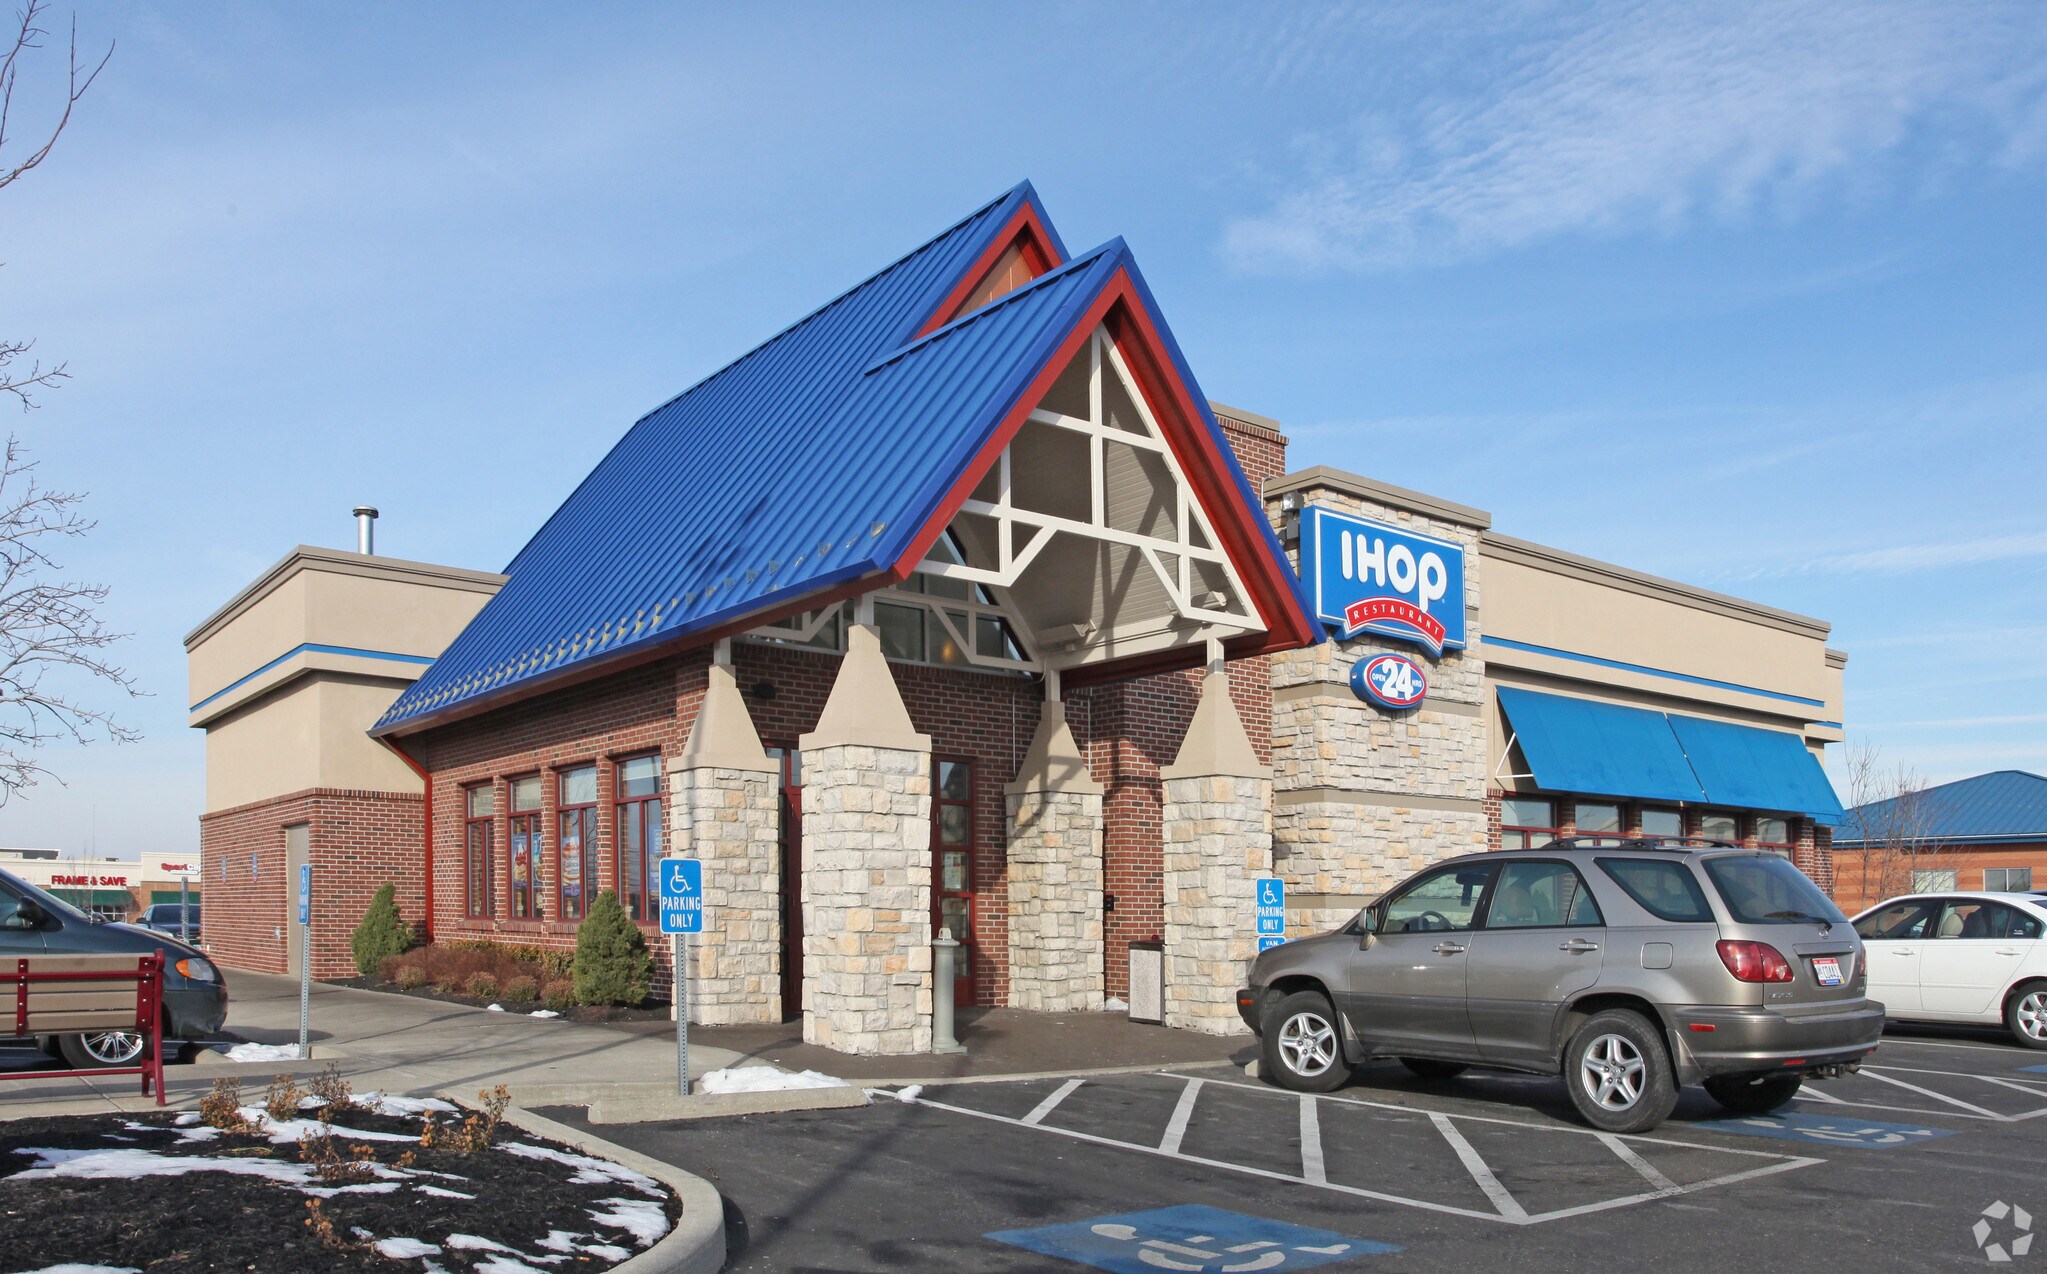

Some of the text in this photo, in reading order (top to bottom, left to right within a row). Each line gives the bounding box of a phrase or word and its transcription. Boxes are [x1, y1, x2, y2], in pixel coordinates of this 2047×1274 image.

[1341, 530, 1447, 613] IHOP
[1353, 603, 1440, 636] RESTAURANT
[1371, 658, 1423, 701] OPEN 24 HRS
[51, 875, 127, 886] FRAME & SAVE
[662, 896, 701, 910] PARKING
[1257, 906, 1284, 917] PARKING
[670, 913, 693, 928] ONLY
[1262, 919, 1279, 930] ONLY
